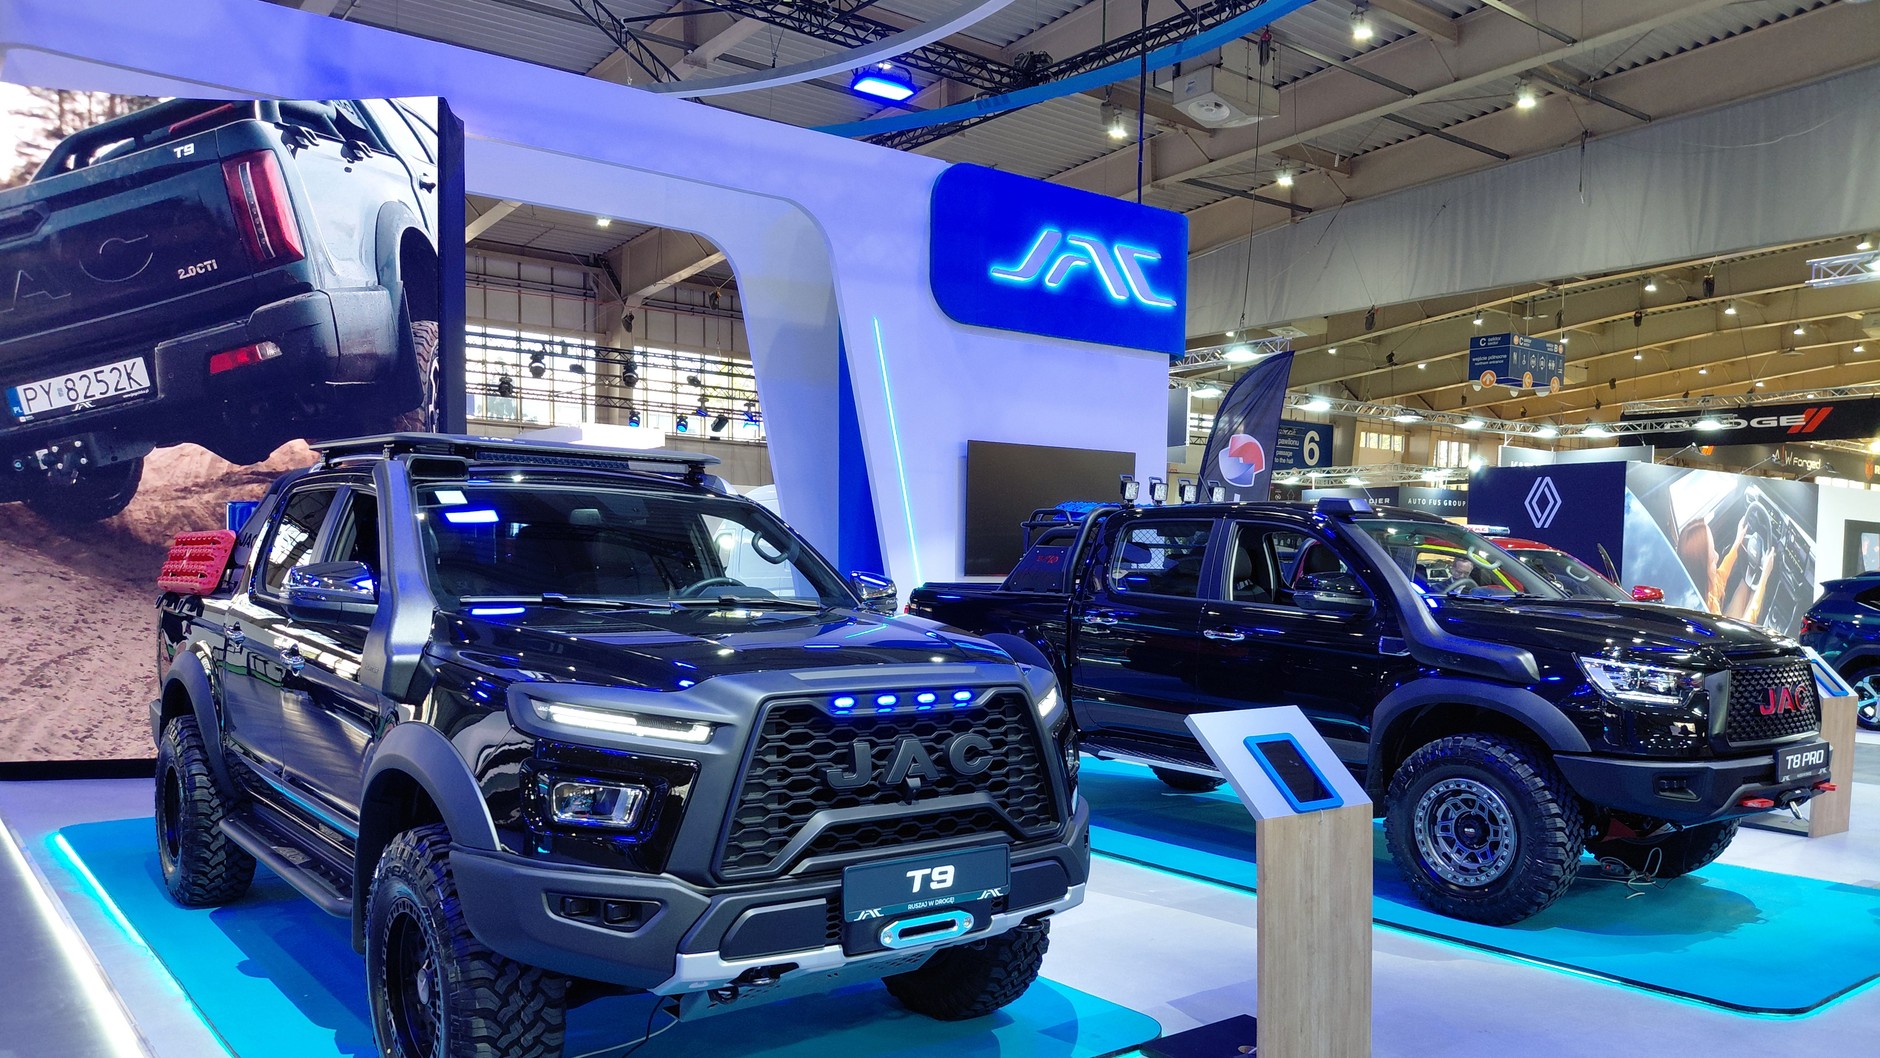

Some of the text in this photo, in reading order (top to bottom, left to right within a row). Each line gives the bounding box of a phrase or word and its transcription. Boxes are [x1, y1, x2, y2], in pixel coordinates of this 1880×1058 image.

[174, 143, 195, 158] T9
[1480, 337, 1487, 347] C
[22, 361, 143, 413] PY 8252K
[1303, 431, 1319, 466] 6
[1443, 499, 1466, 507] GROUP
[1760, 684, 1808, 716] JAC
[826, 733, 994, 789] JAC
[1785, 750, 1824, 769] T8 PRO
[906, 864, 955, 893] T9
[907, 901, 928, 910] RUSZAJ
